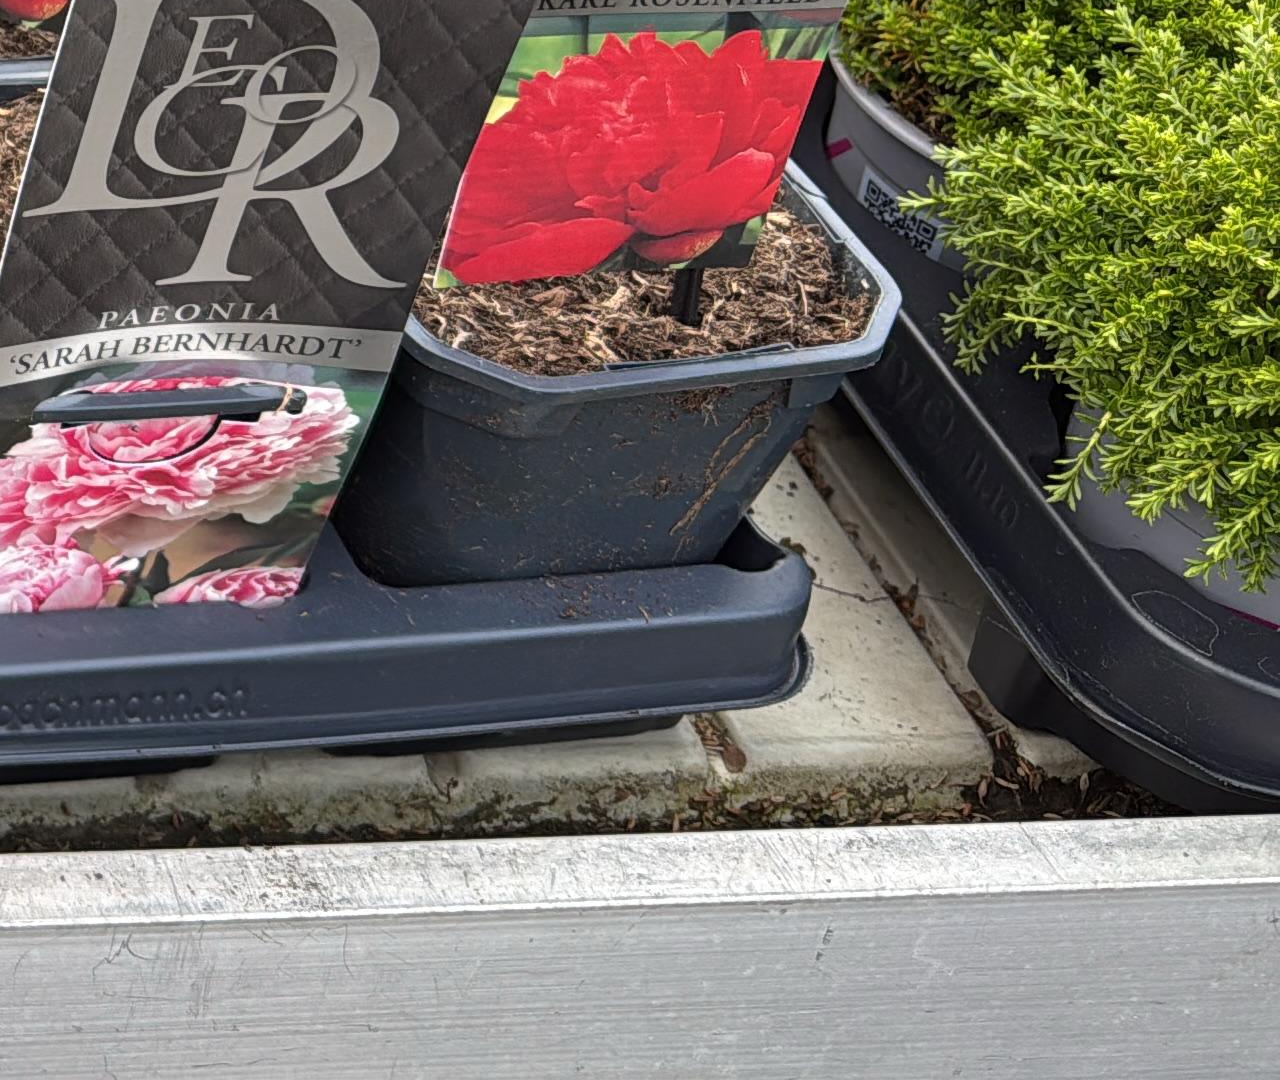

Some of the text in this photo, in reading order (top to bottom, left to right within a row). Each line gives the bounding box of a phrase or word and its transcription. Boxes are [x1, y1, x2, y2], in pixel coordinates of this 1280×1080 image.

[97, 302, 281, 330] PAEONIA
[9, 332, 364, 376] 'SARAH BERNHARDT'
